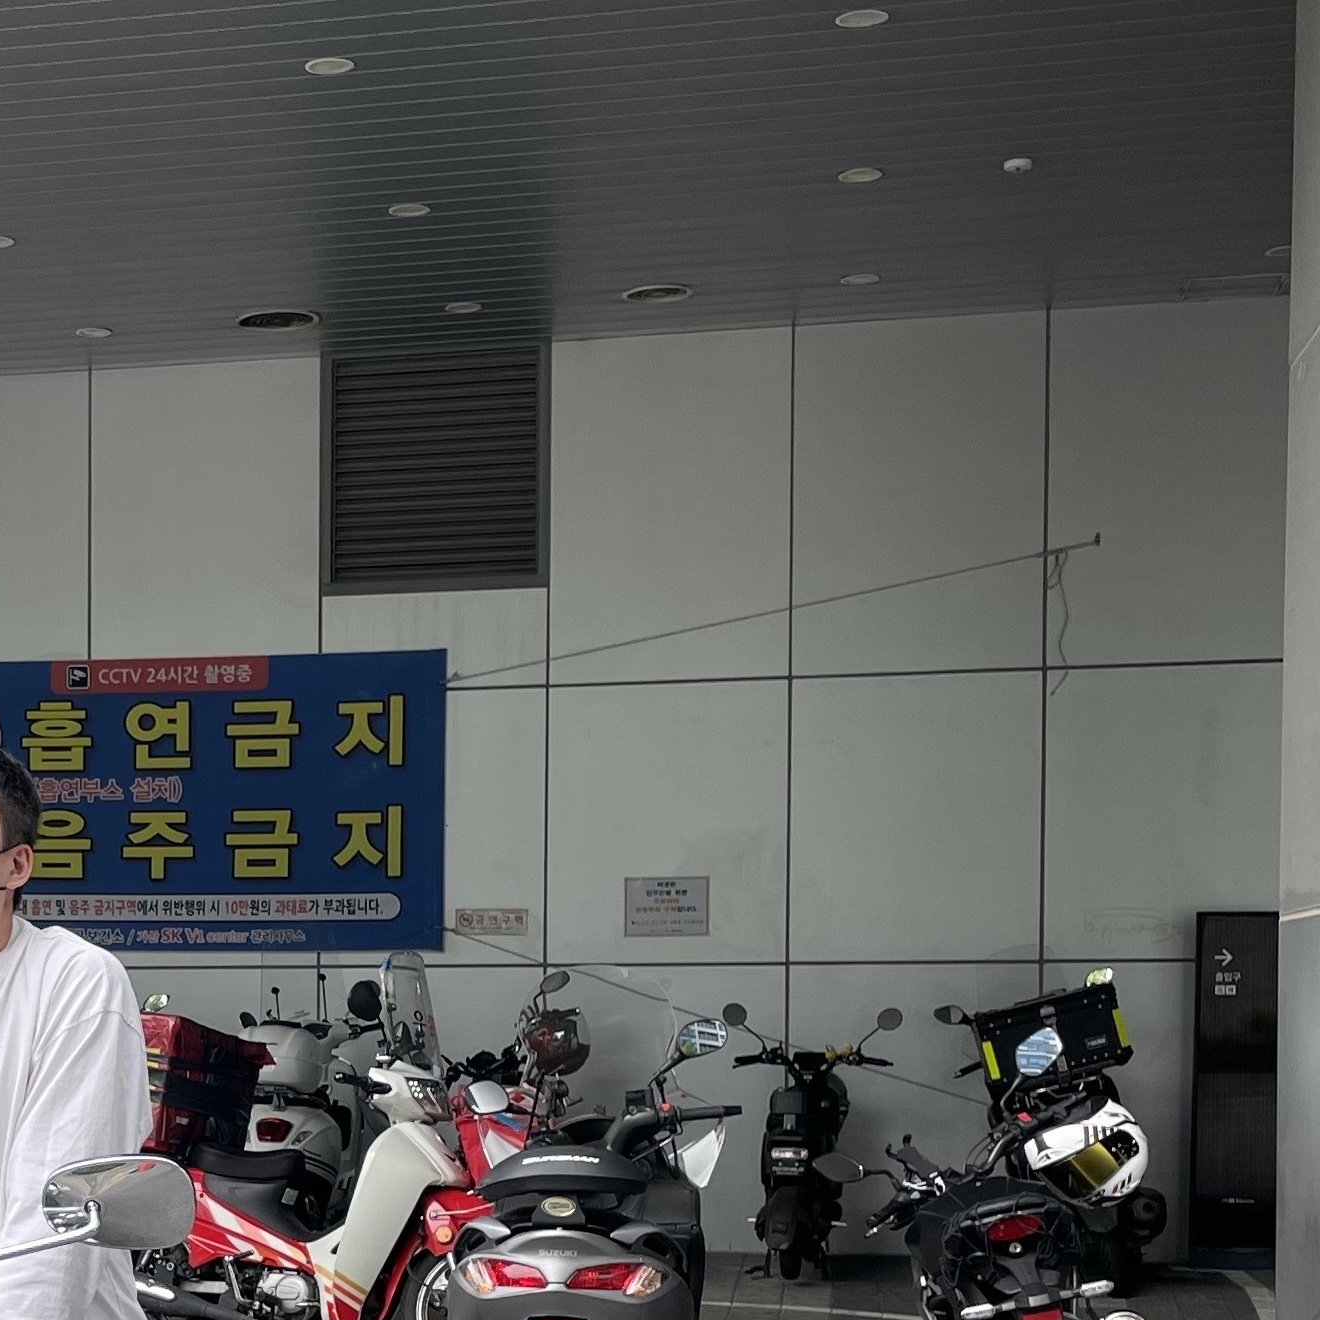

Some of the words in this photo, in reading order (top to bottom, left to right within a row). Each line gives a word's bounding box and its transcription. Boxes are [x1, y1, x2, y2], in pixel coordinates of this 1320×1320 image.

[98, 668, 142, 685] CCTV
[146, 665, 199, 685] 24시간
[204, 664, 252, 684] 촬영중
[130, 775, 183, 804] 설치)
[31, 899, 52, 916] 흡연
[55, 899, 66, 917] 및
[69, 899, 90, 916] 음주
[94, 899, 159, 917] 금지구역에서
[162, 899, 206, 917] 위반행위
[210, 899, 220, 917] 시
[225, 899, 271, 917] 10만원의
[274, 899, 319, 916] 과태료가
[323, 898, 384, 916] 부과됩니다.
[160, 927, 184, 944] SK
[185, 927, 205, 944] V1
[206, 929, 250, 944] center
[250, 928, 307, 945] 관리사무소
[538, 1249, 578, 1257] SUZUKI
